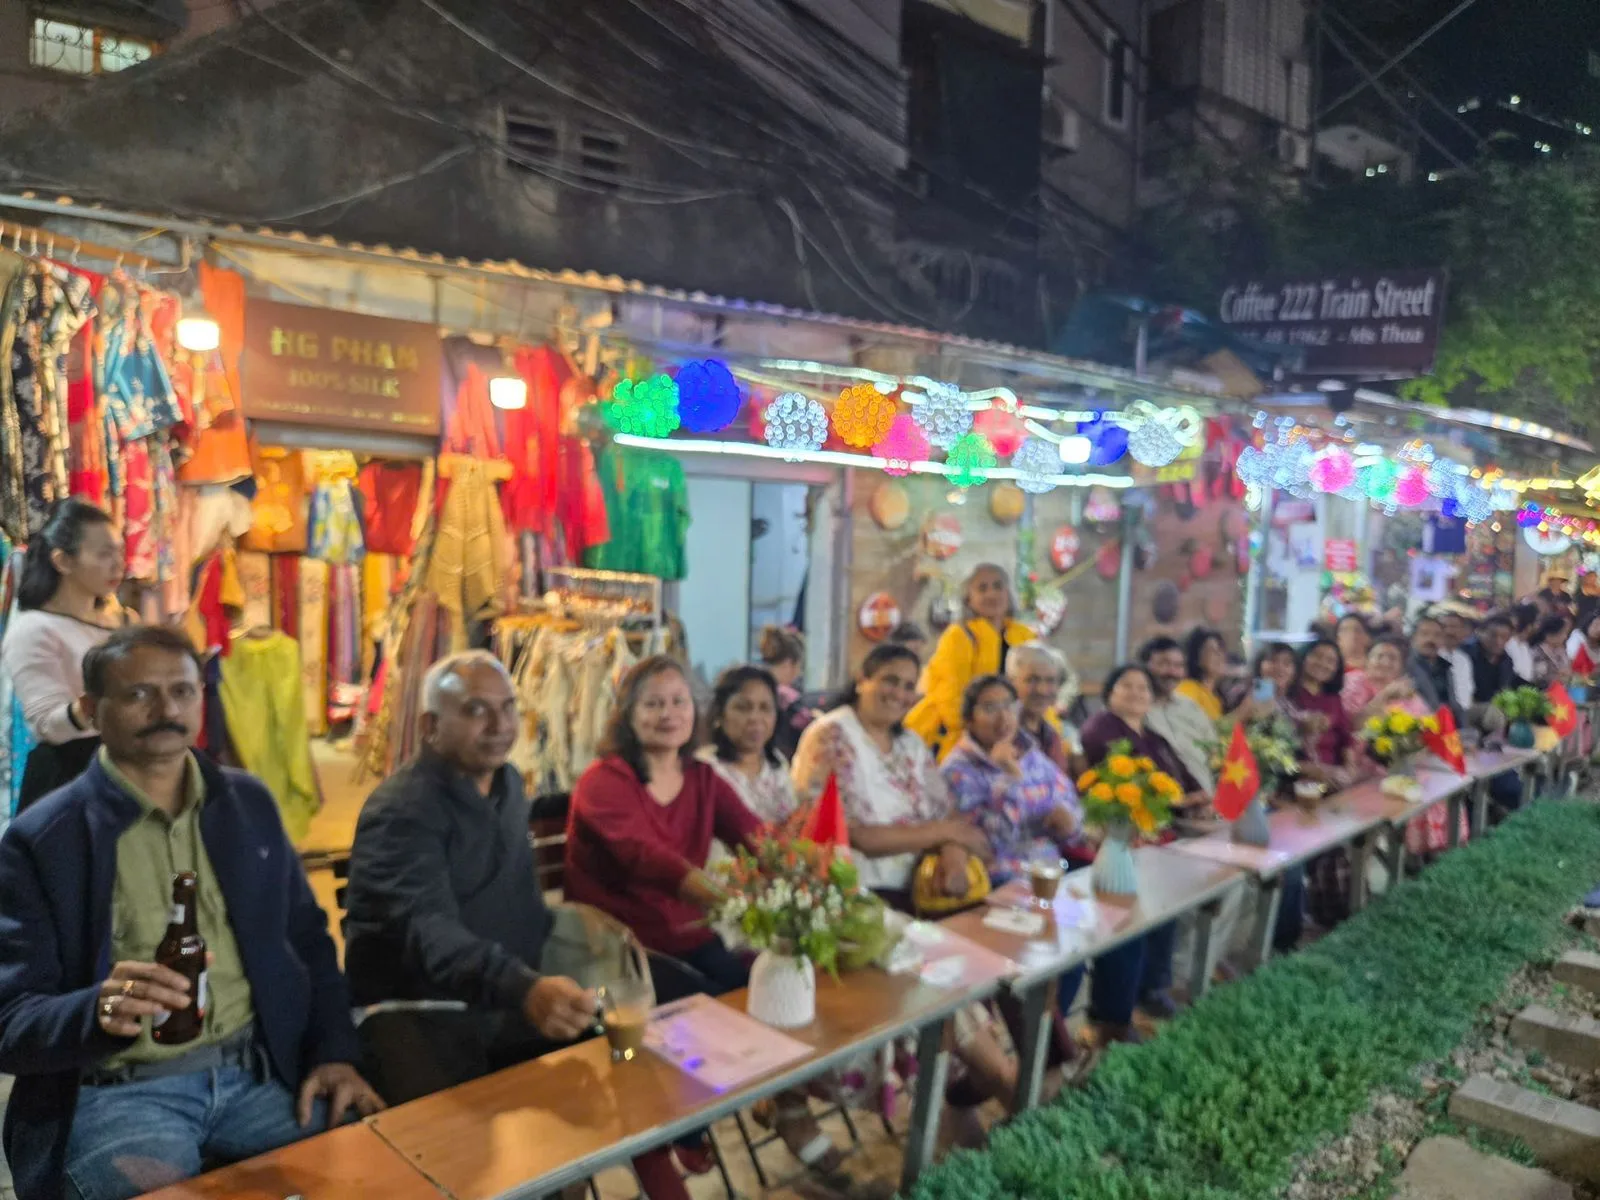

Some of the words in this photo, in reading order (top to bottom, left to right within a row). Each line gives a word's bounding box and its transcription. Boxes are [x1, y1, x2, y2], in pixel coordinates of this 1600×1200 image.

[1220, 281, 1276, 323] Coffee
[1279, 284, 1318, 321] 222
[1320, 277, 1371, 319] Train
[1372, 277, 1435, 318] Street
[270, 325, 319, 359] HG
[347, 374, 401, 399] SILK
